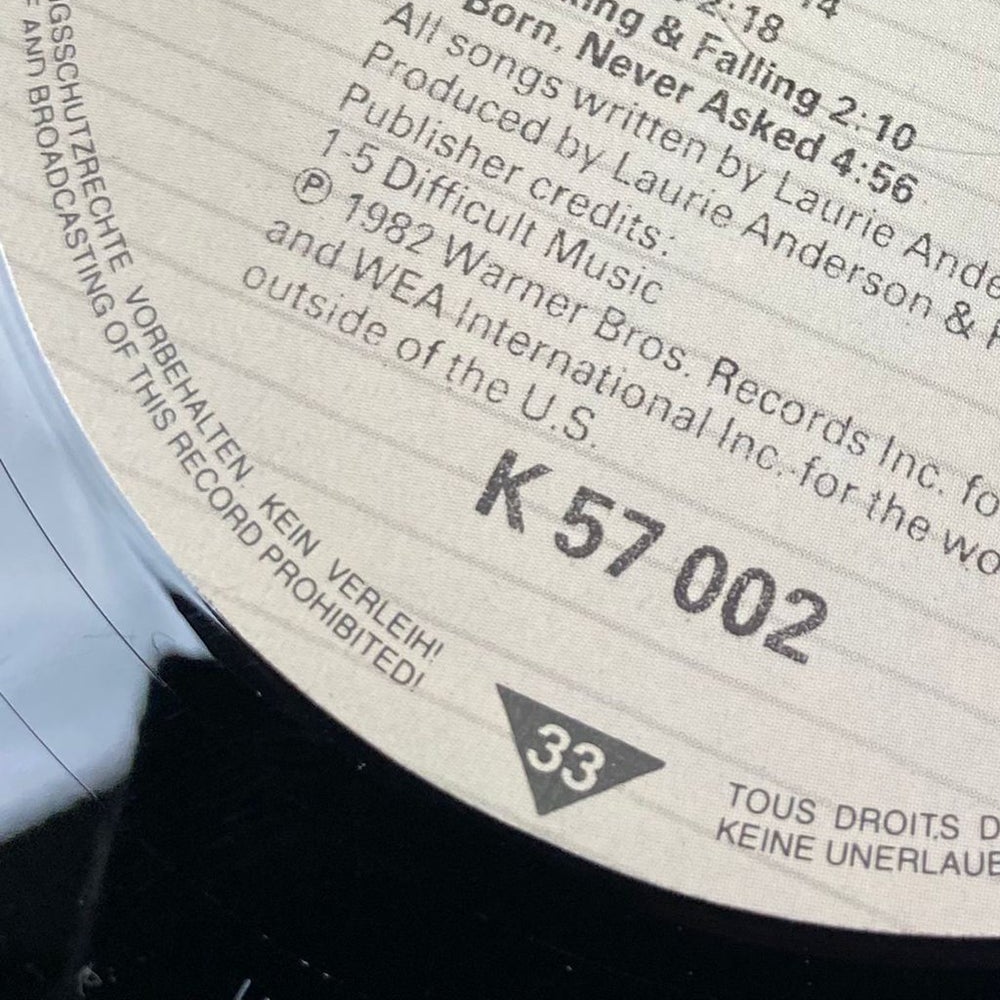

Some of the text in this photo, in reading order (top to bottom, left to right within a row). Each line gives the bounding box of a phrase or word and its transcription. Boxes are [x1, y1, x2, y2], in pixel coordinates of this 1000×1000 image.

[381, 0, 444, 45] All
[444, 32, 565, 100] songs
[572, 85, 708, 164] written
[714, 143, 768, 194] by
[772, 169, 896, 249] Laurie
[574, 29, 695, 104] Never
[696, 88, 827, 164] Asked
[829, 146, 920, 205] 4:56
[650, 13, 685, 52] &
[691, 30, 823, 119] Falling
[827, 94, 918, 152] 2:10
[25, 83, 116, 319] BROADCASTING
[320, 127, 664, 305] 1-5 Difficult Music
[338, 81, 676, 257] Publisher credits:
[360, 39, 552, 146] Produced
[552, 123, 607, 175] by
[610, 150, 734, 229] Laurie
[739, 211, 933, 320] Anderson
[942, 299, 976, 341] &
[102, 319, 141, 359] OF
[127, 361, 177, 432] THIS
[241, 264, 597, 449] outside of the U.S.
[263, 219, 347, 270] and
[352, 246, 445, 319] WEA
[453, 296, 714, 439] International
[716, 415, 783, 477] Inc.
[798, 454, 860, 505] for
[865, 489, 932, 543] the
[344, 192, 435, 255] 1982
[441, 232, 590, 324] Warner
[591, 304, 690, 379] Bros.
[705, 354, 871, 457] Records
[877, 434, 944, 496] Inc.
[166, 429, 264, 547] RECORD
[257, 492, 321, 558] KEIN
[473, 448, 828, 666] K 57 002
[257, 542, 426, 693] PROHIBITED!
[326, 557, 445, 663] VERLEIH!
[525, 724, 605, 792] 33
[730, 781, 817, 826] TOUS
[833, 802, 960, 841] DROITS
[714, 816, 817, 861] KEINE
